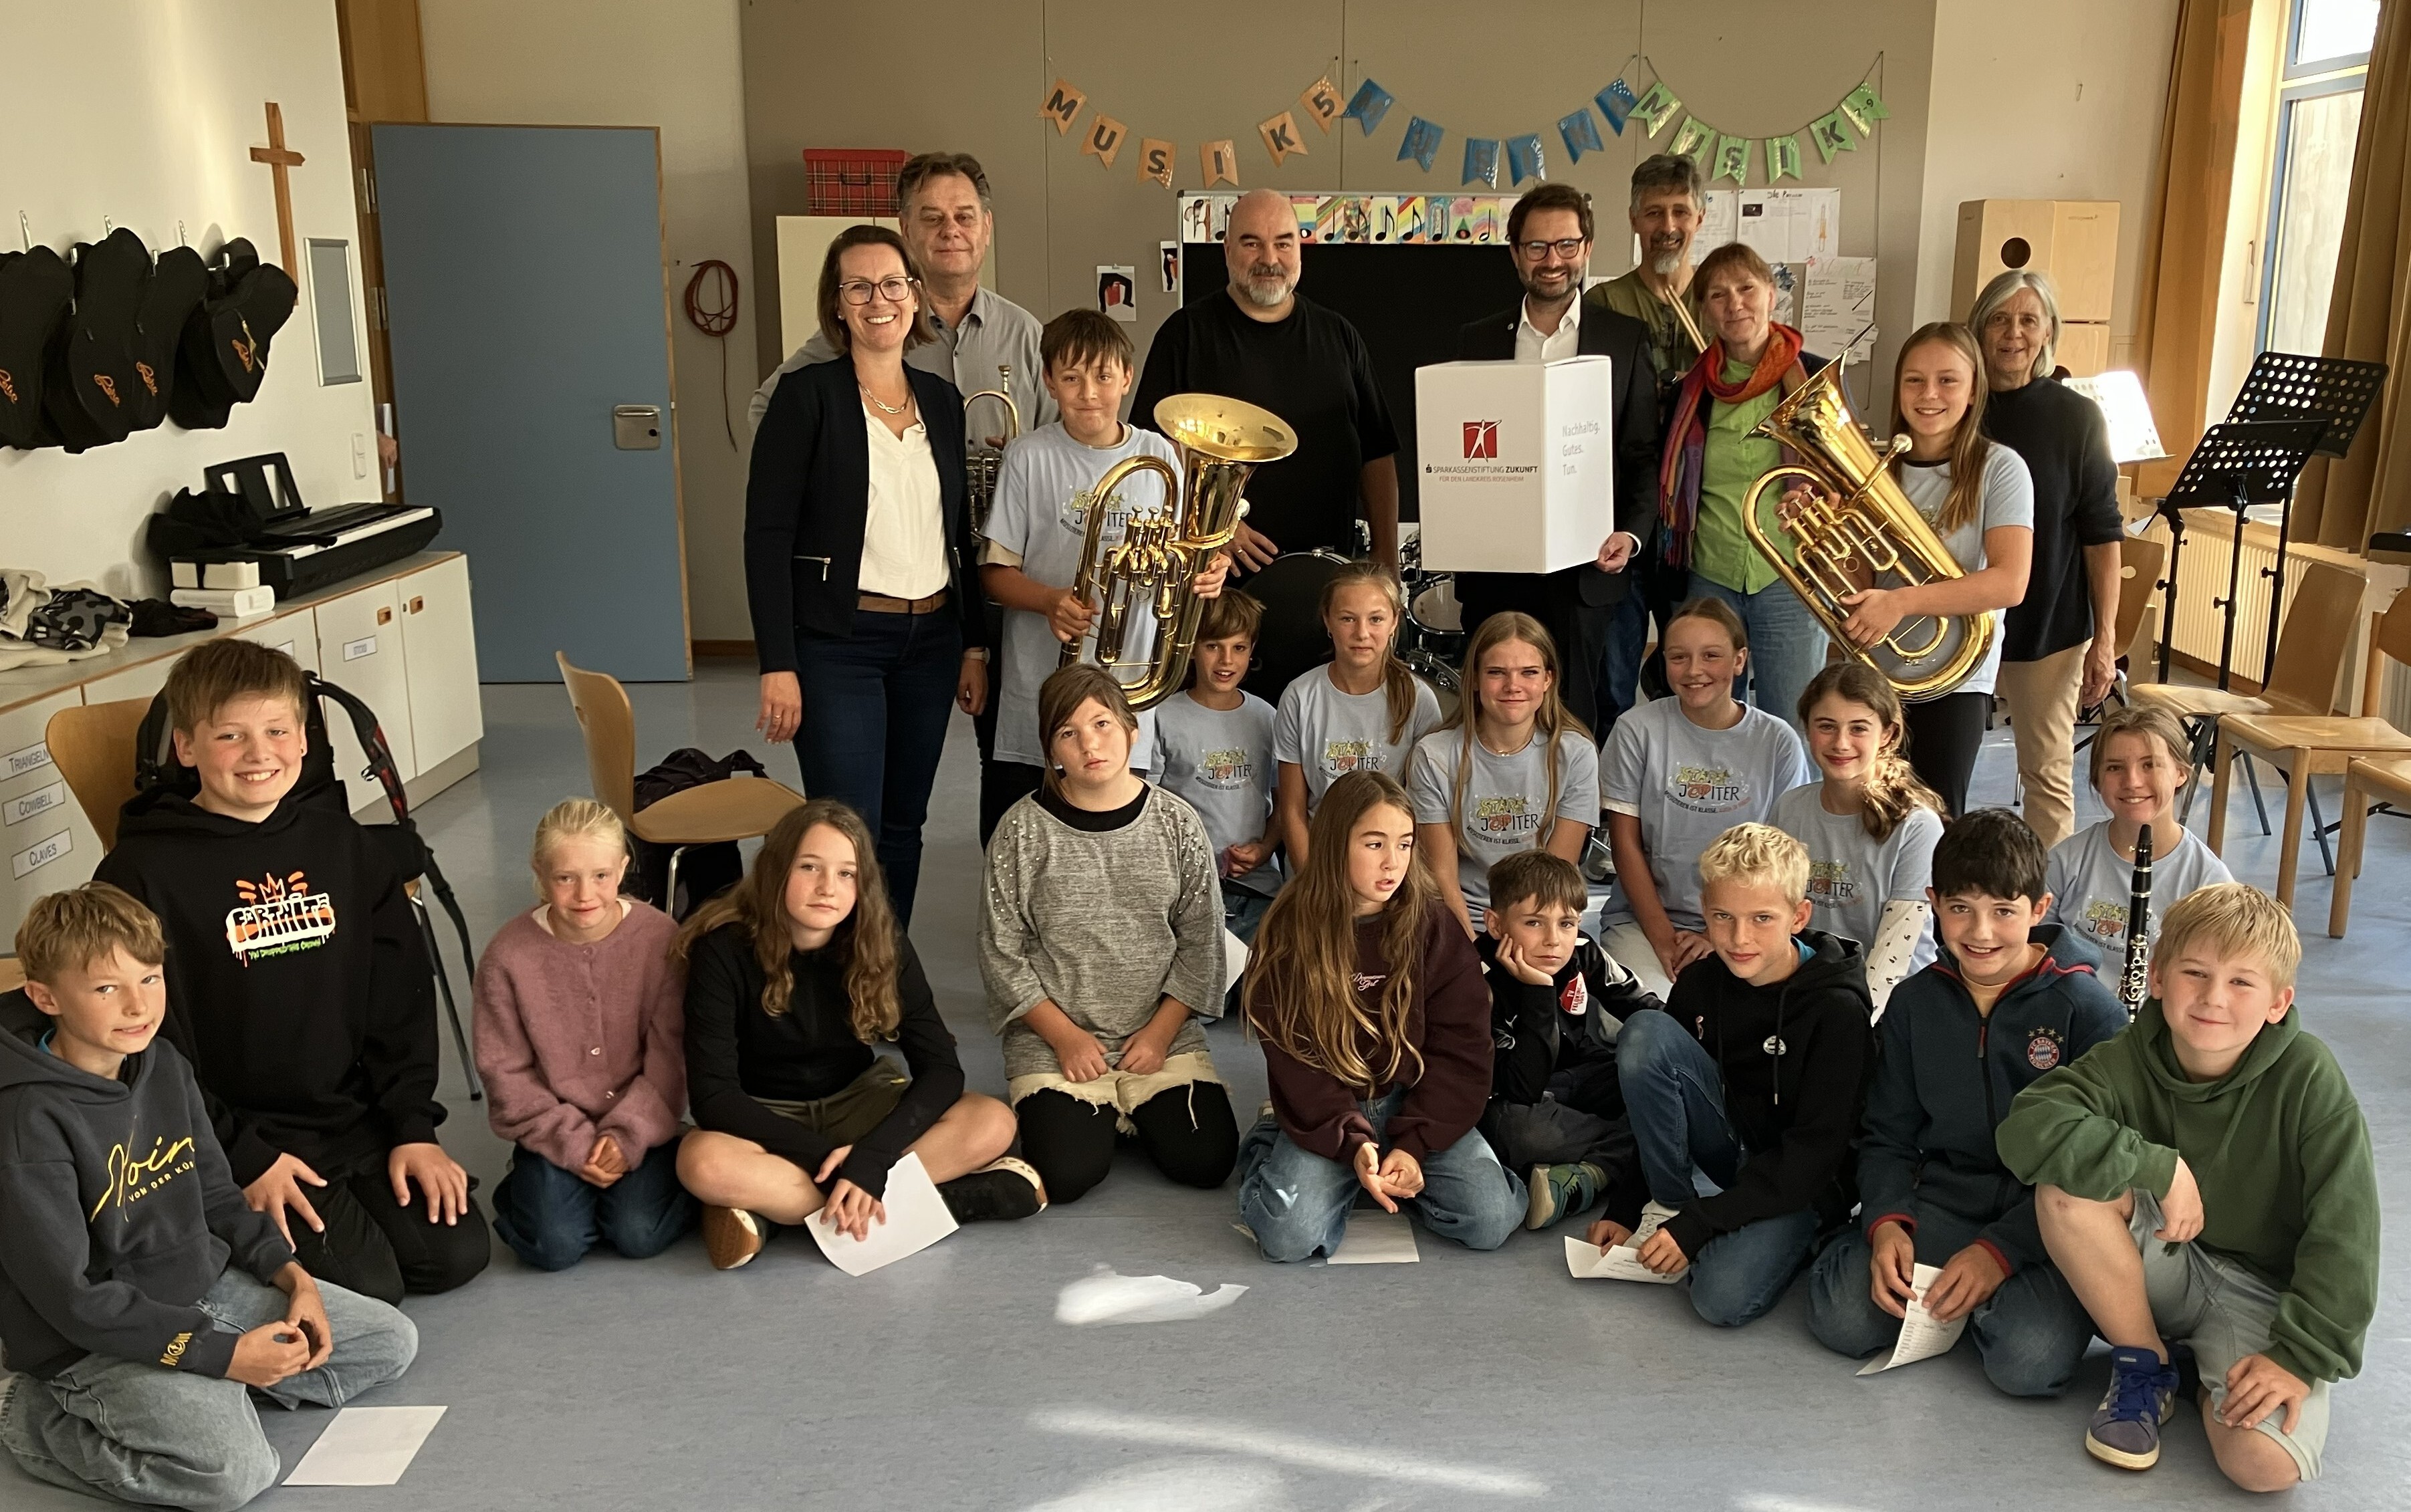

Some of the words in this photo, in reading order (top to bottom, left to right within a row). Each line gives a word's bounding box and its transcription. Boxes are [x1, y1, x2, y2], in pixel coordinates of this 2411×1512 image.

[1312, 90, 1335, 118] 5
[1562, 444, 1584, 457] Gutes.
[1208, 763, 1252, 780] JUPITER
[1330, 756, 1379, 771] JUPITER
[1678, 783, 1740, 801] JUPITER
[19, 791, 53, 816] COWBELL
[1480, 813, 1540, 832] JUPITER
[29, 843, 58, 866] CLAVES
[2037, 1039, 2057, 1053] BAYERN
[128, 1186, 148, 1202] VON
[150, 1172, 172, 1189] DER
